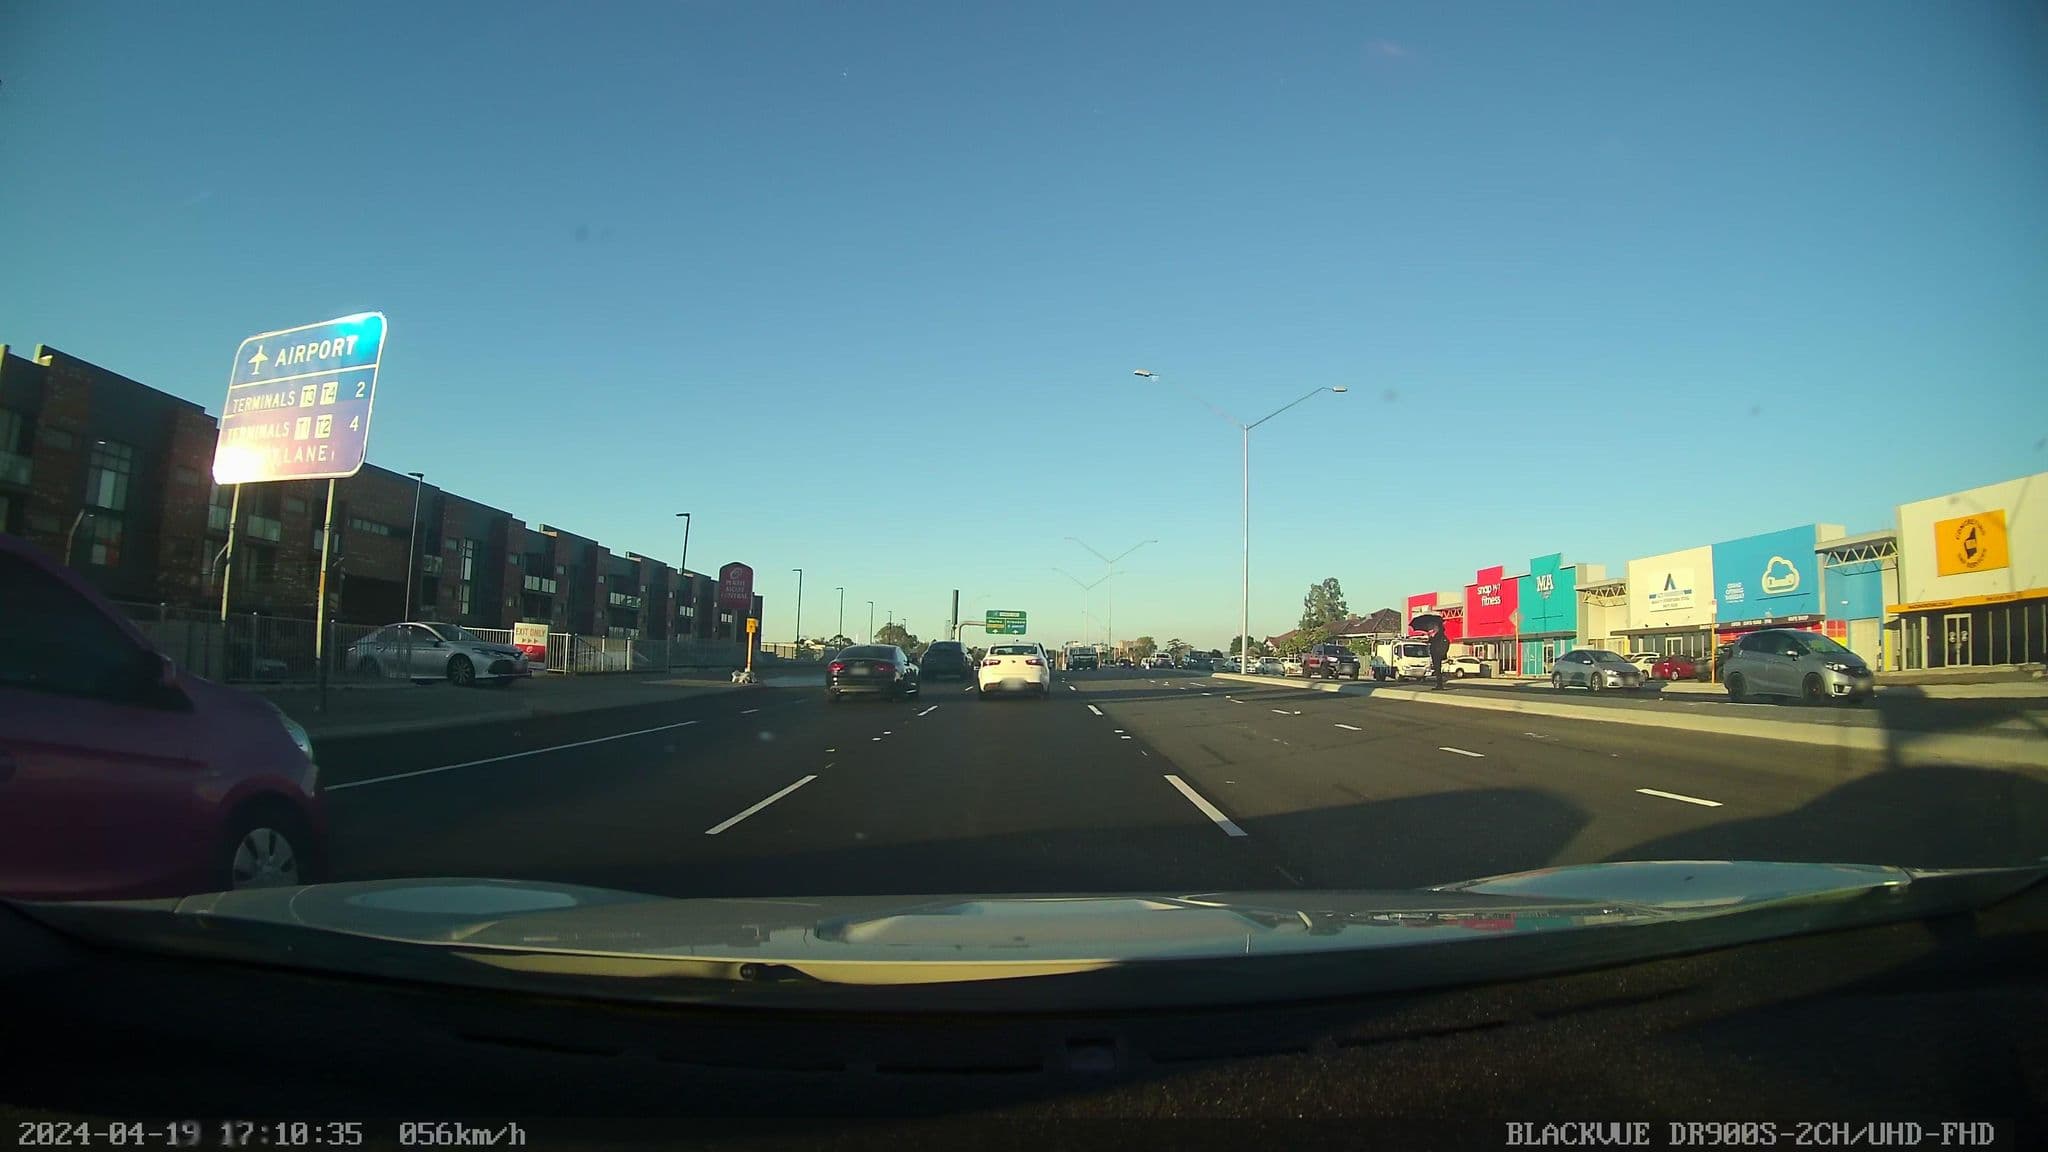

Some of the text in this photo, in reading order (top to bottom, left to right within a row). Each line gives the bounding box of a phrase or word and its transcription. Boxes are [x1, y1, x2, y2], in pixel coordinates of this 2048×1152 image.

[275, 335, 359, 367] AIRPORT
[233, 390, 296, 414] TERMINALS
[355, 381, 366, 398] 2
[349, 415, 359, 432] 4
[1477, 585, 1491, 596] snap
[1481, 596, 1501, 607] fitness
[516, 628, 546, 637] EXIT ONLY
